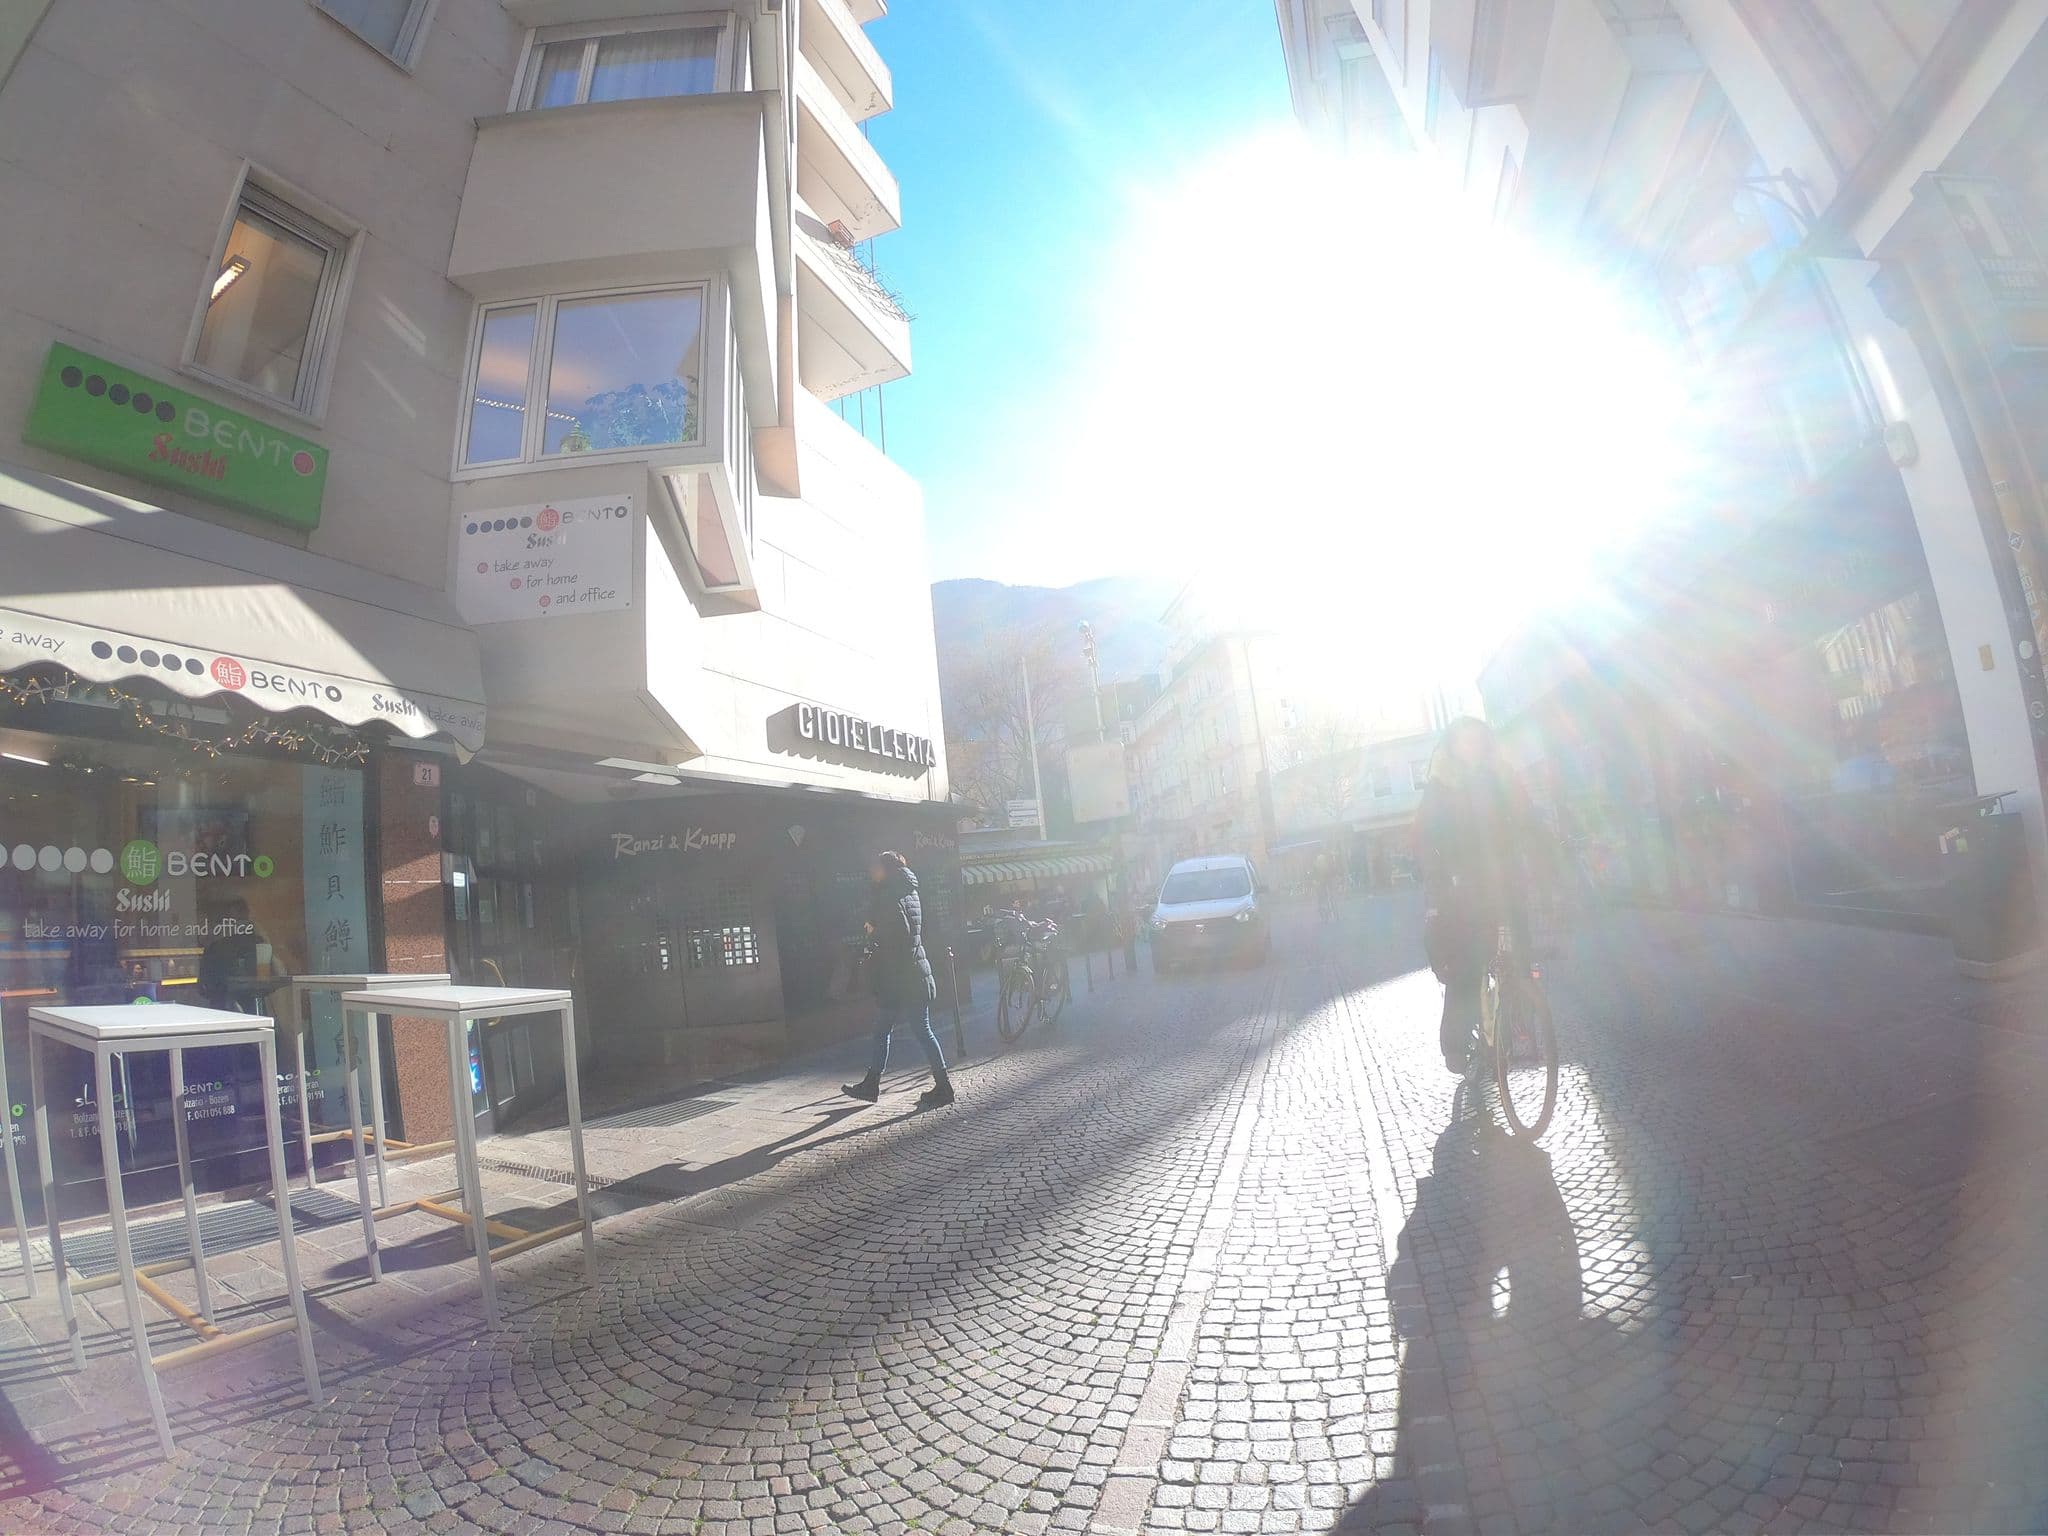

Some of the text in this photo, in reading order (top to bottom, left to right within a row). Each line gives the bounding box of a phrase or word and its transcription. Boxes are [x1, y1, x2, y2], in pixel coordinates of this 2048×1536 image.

[148, 433, 229, 481] Sushi
[562, 506, 628, 524] BNTO
[494, 558, 553, 573] take away
[526, 572, 578, 588] for home
[556, 587, 615, 604] and office
[11, 632, 65, 653] away
[251, 670, 342, 702] BENTO
[372, 693, 415, 716] Sushi
[798, 702, 936, 767] GIOIELLERIA
[611, 827, 736, 859] Ranzi & Knapp
[167, 851, 274, 879] BENTO
[116, 887, 170, 913] Sushi
[23, 918, 254, 940] take away for home and office
